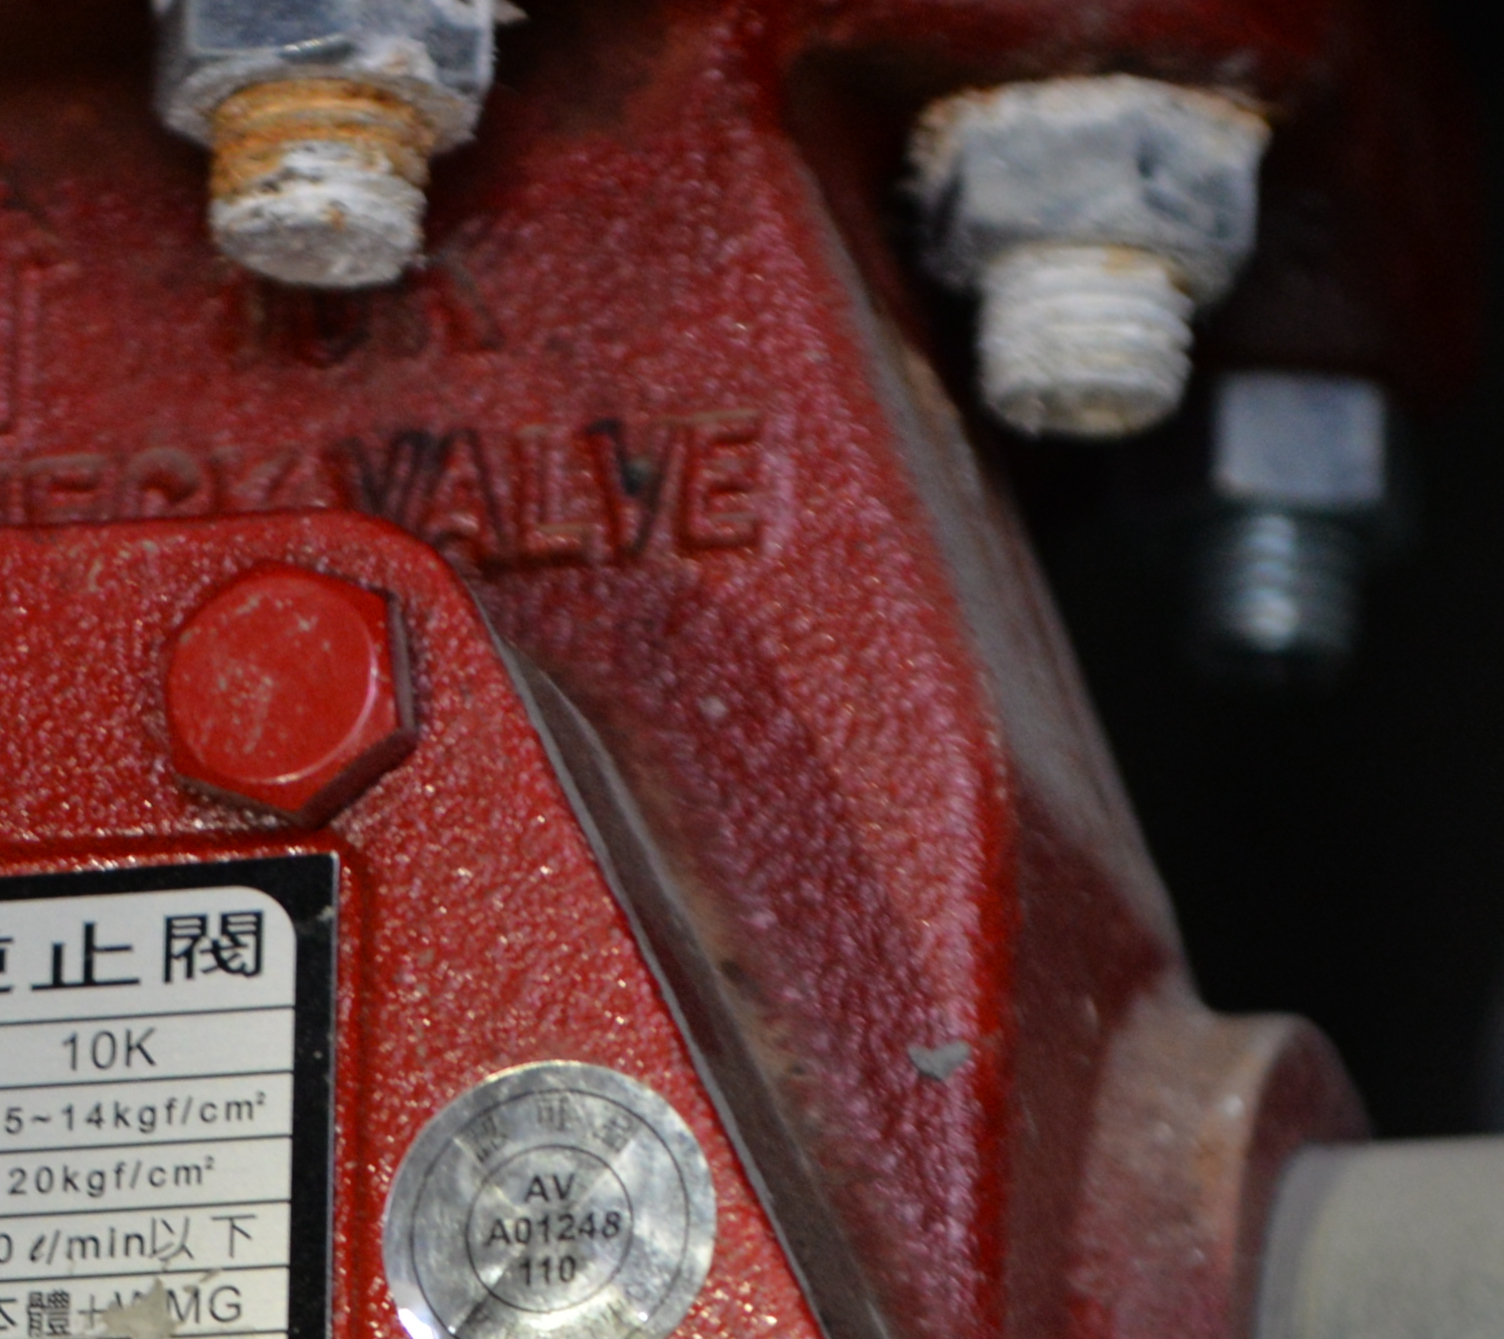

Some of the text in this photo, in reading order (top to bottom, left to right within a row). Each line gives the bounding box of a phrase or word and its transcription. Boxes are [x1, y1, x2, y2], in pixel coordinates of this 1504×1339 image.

[62, 1027, 158, 1072] 10K
[523, 1173, 576, 1203] AV
[485, 1211, 623, 1247] A01248
[521, 1254, 578, 1287] 110
